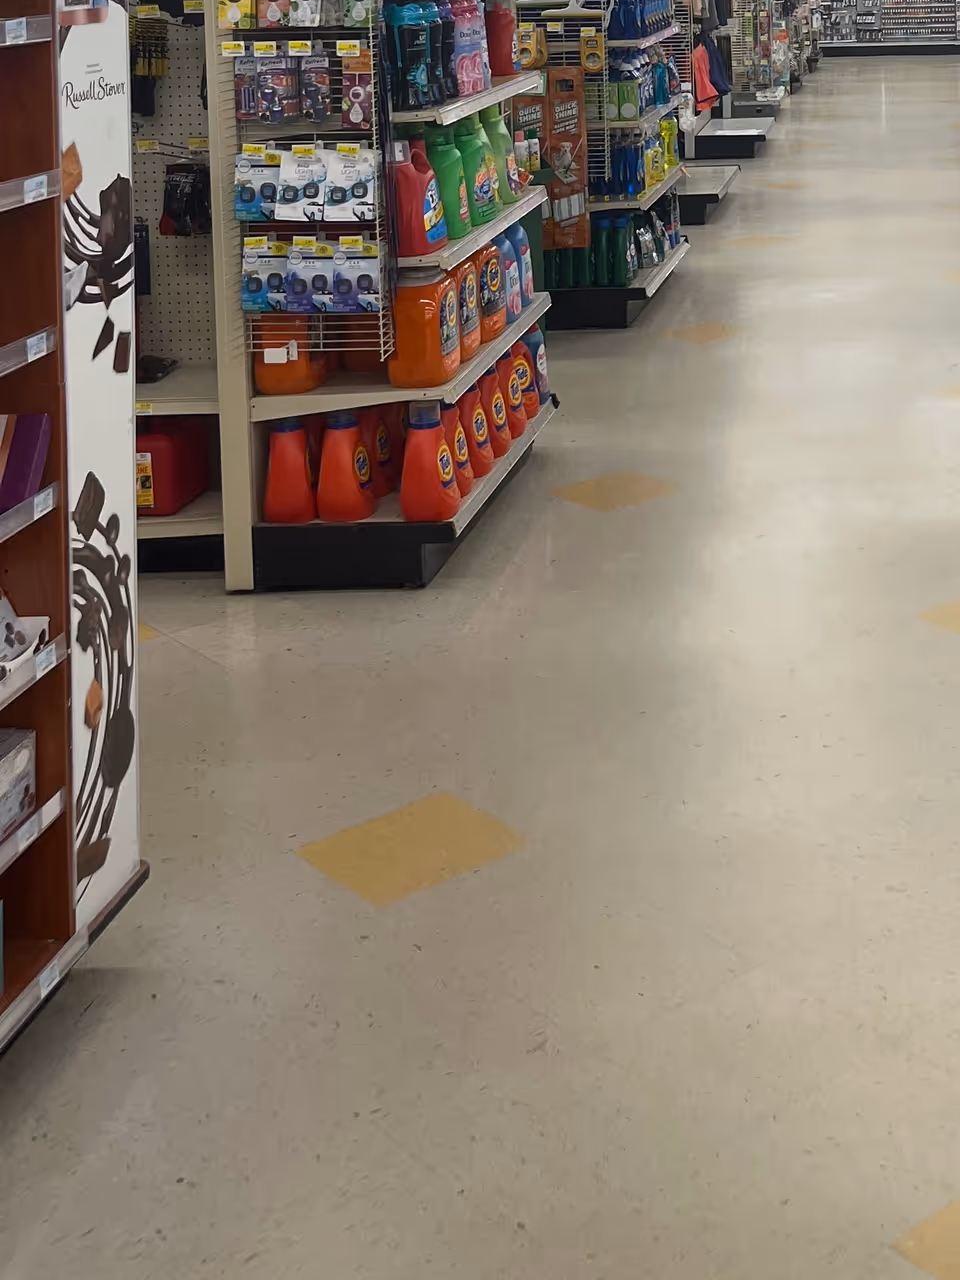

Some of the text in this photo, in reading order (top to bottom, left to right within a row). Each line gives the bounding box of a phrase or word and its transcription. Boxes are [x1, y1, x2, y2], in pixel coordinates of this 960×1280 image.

[62, 76, 126, 109] Russell Stover
[518, 105, 541, 116] QUICK
[555, 100, 577, 112] QUICK
[519, 111, 542, 123] SHINE
[555, 108, 577, 120] SHINE
[474, 416, 486, 438] Tide
[439, 455, 451, 475] Tide
